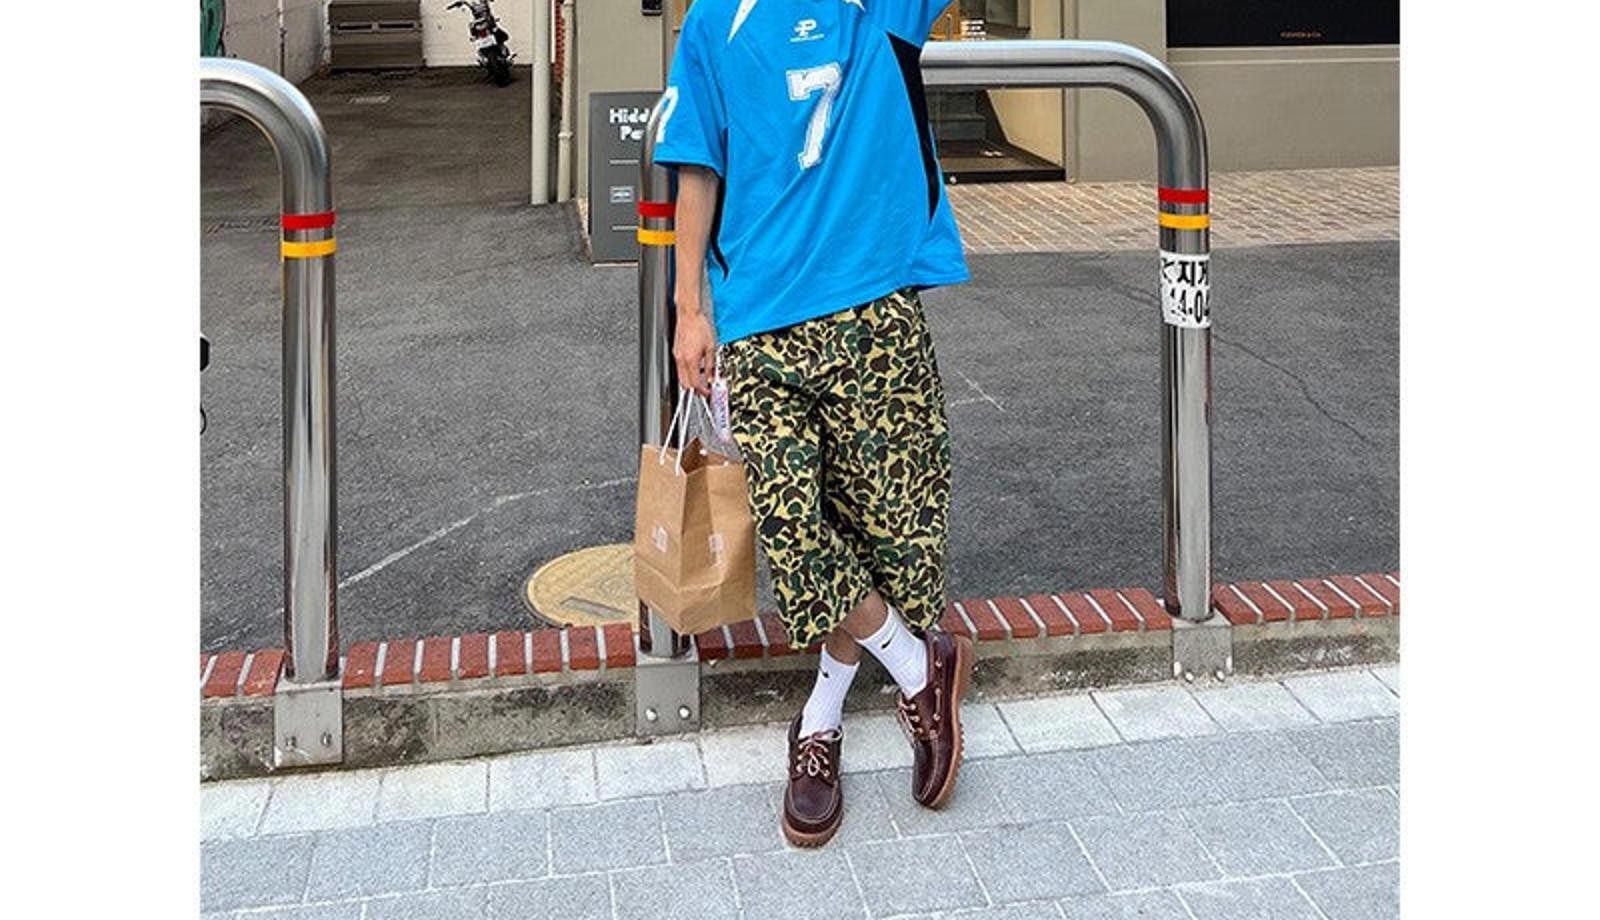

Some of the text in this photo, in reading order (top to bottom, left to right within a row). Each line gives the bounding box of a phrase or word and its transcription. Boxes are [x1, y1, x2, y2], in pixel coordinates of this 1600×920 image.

[609, 107, 650, 124] Hidd
[785, 62, 841, 171] 7
[620, 125, 645, 141] Pa
